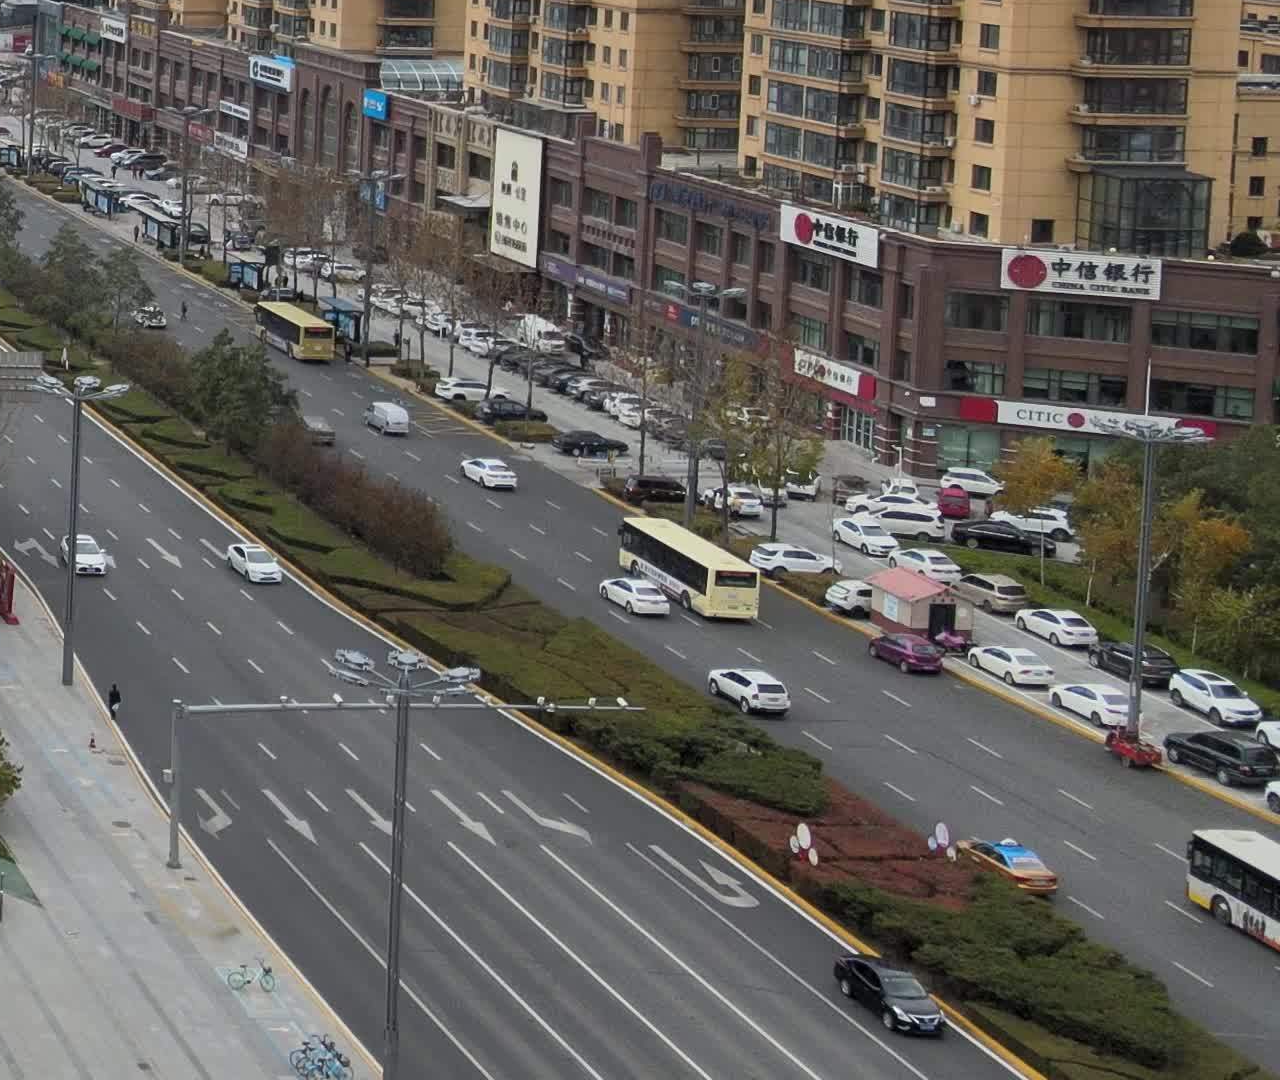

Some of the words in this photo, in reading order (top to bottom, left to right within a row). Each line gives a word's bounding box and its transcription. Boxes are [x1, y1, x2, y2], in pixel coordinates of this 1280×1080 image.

[1051, 258, 1155, 284] 中信银行
[1016, 409, 1063, 425] CITIC
